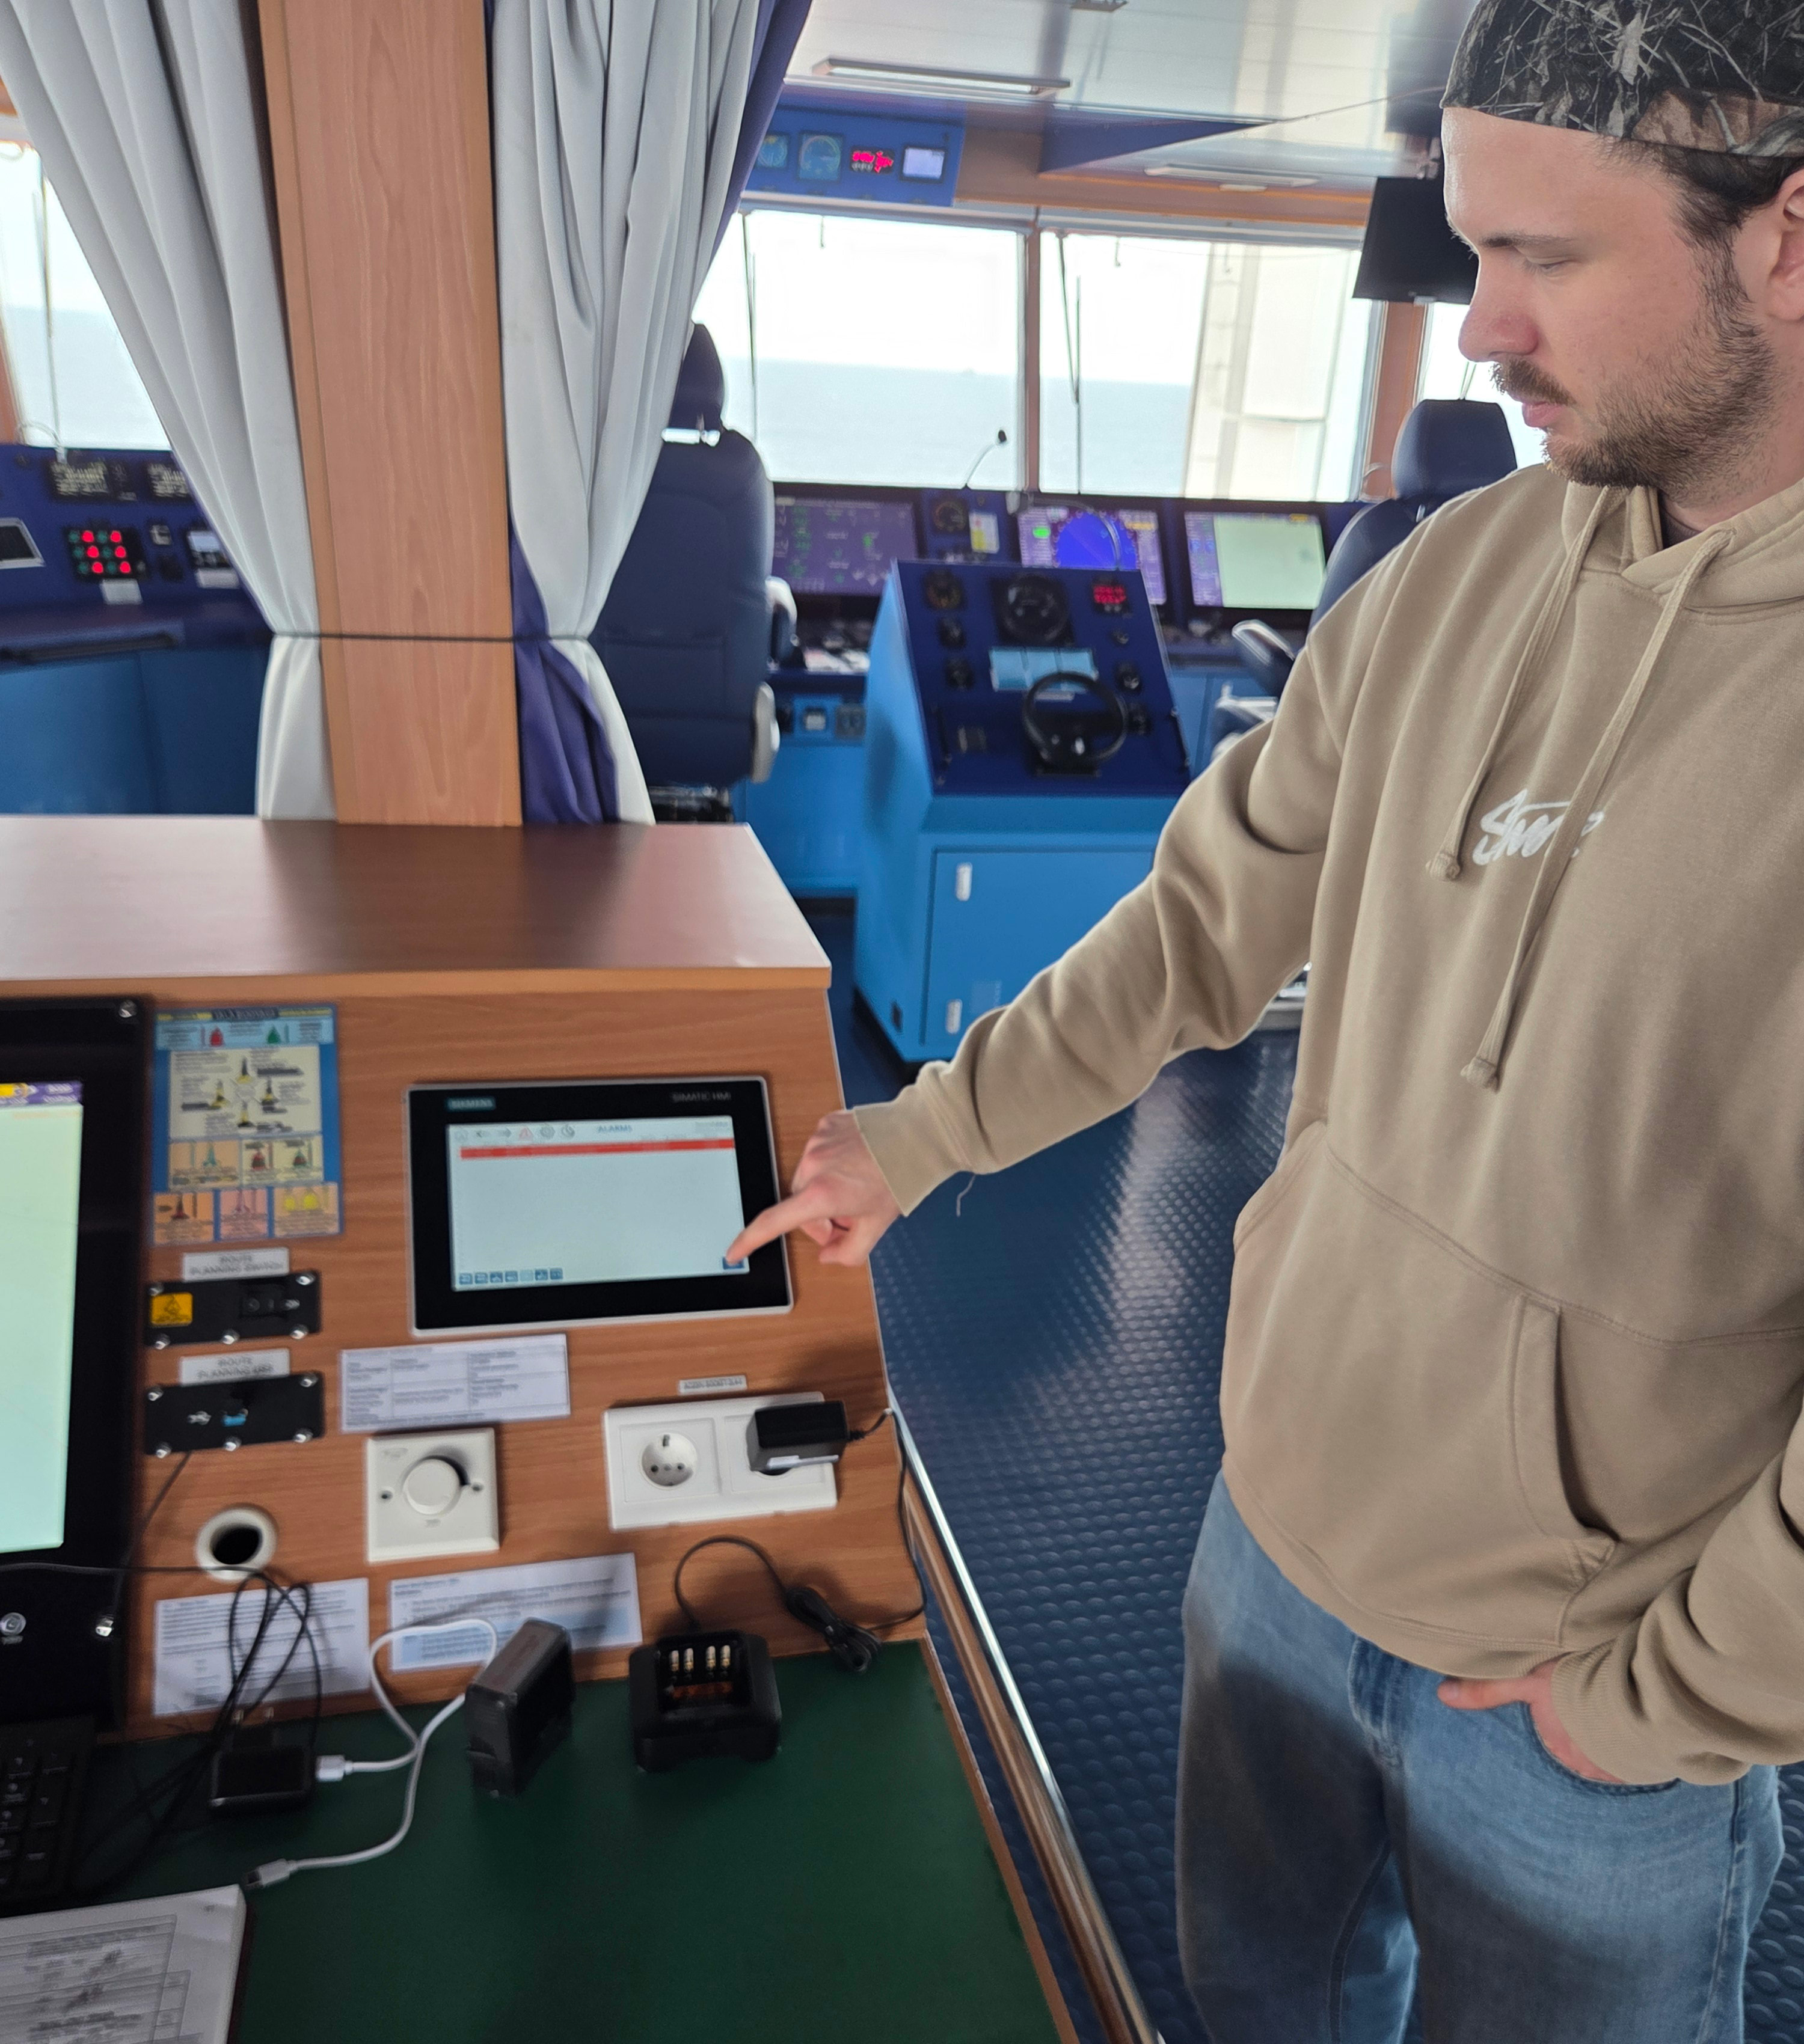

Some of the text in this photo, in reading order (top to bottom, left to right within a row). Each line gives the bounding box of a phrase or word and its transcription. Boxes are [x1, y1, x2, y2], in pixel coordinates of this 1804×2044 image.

[672, 1092, 710, 1103] SIMATIC
[451, 1098, 493, 1109] SIEMENS
[189, 1264, 241, 1276] PLANNING
[196, 1366, 251, 1379] PLANNING
